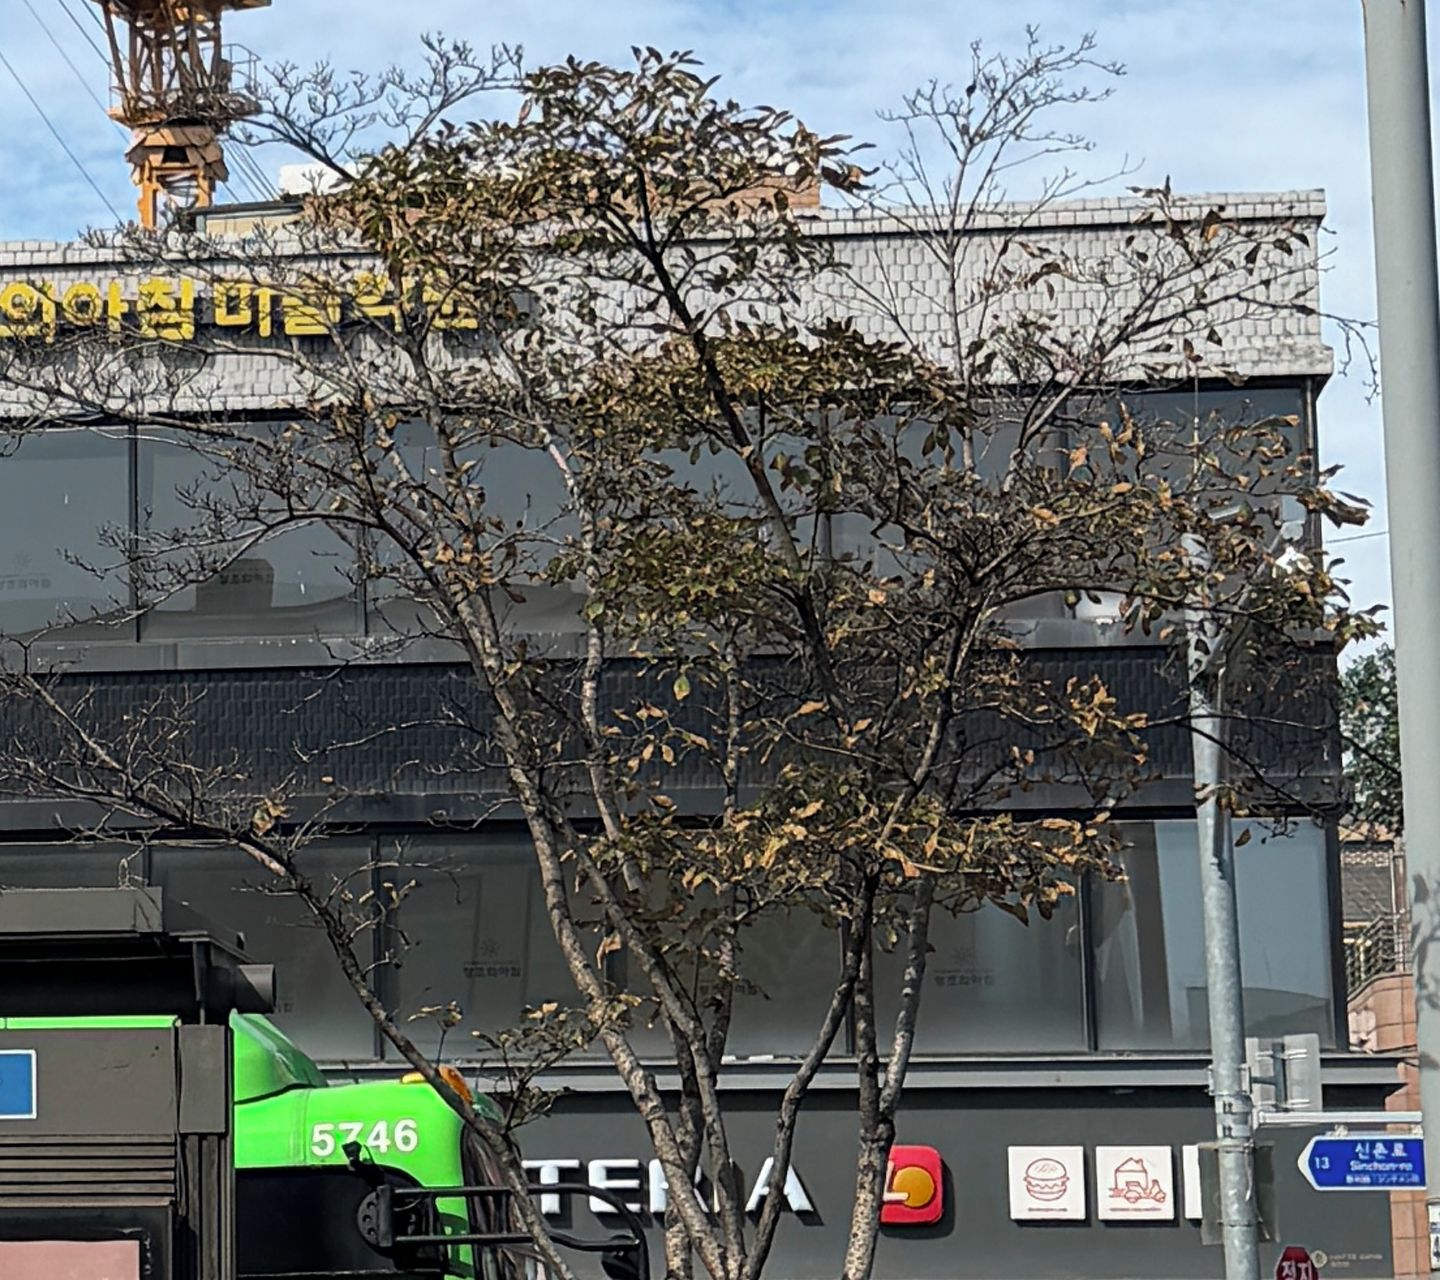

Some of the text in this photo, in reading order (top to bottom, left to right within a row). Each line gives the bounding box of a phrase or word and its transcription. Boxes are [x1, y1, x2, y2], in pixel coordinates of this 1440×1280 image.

[310, 1117, 420, 1158] 5746
[1354, 1141, 1408, 1160] 신촌로
[1314, 1156, 1330, 1170] 13
